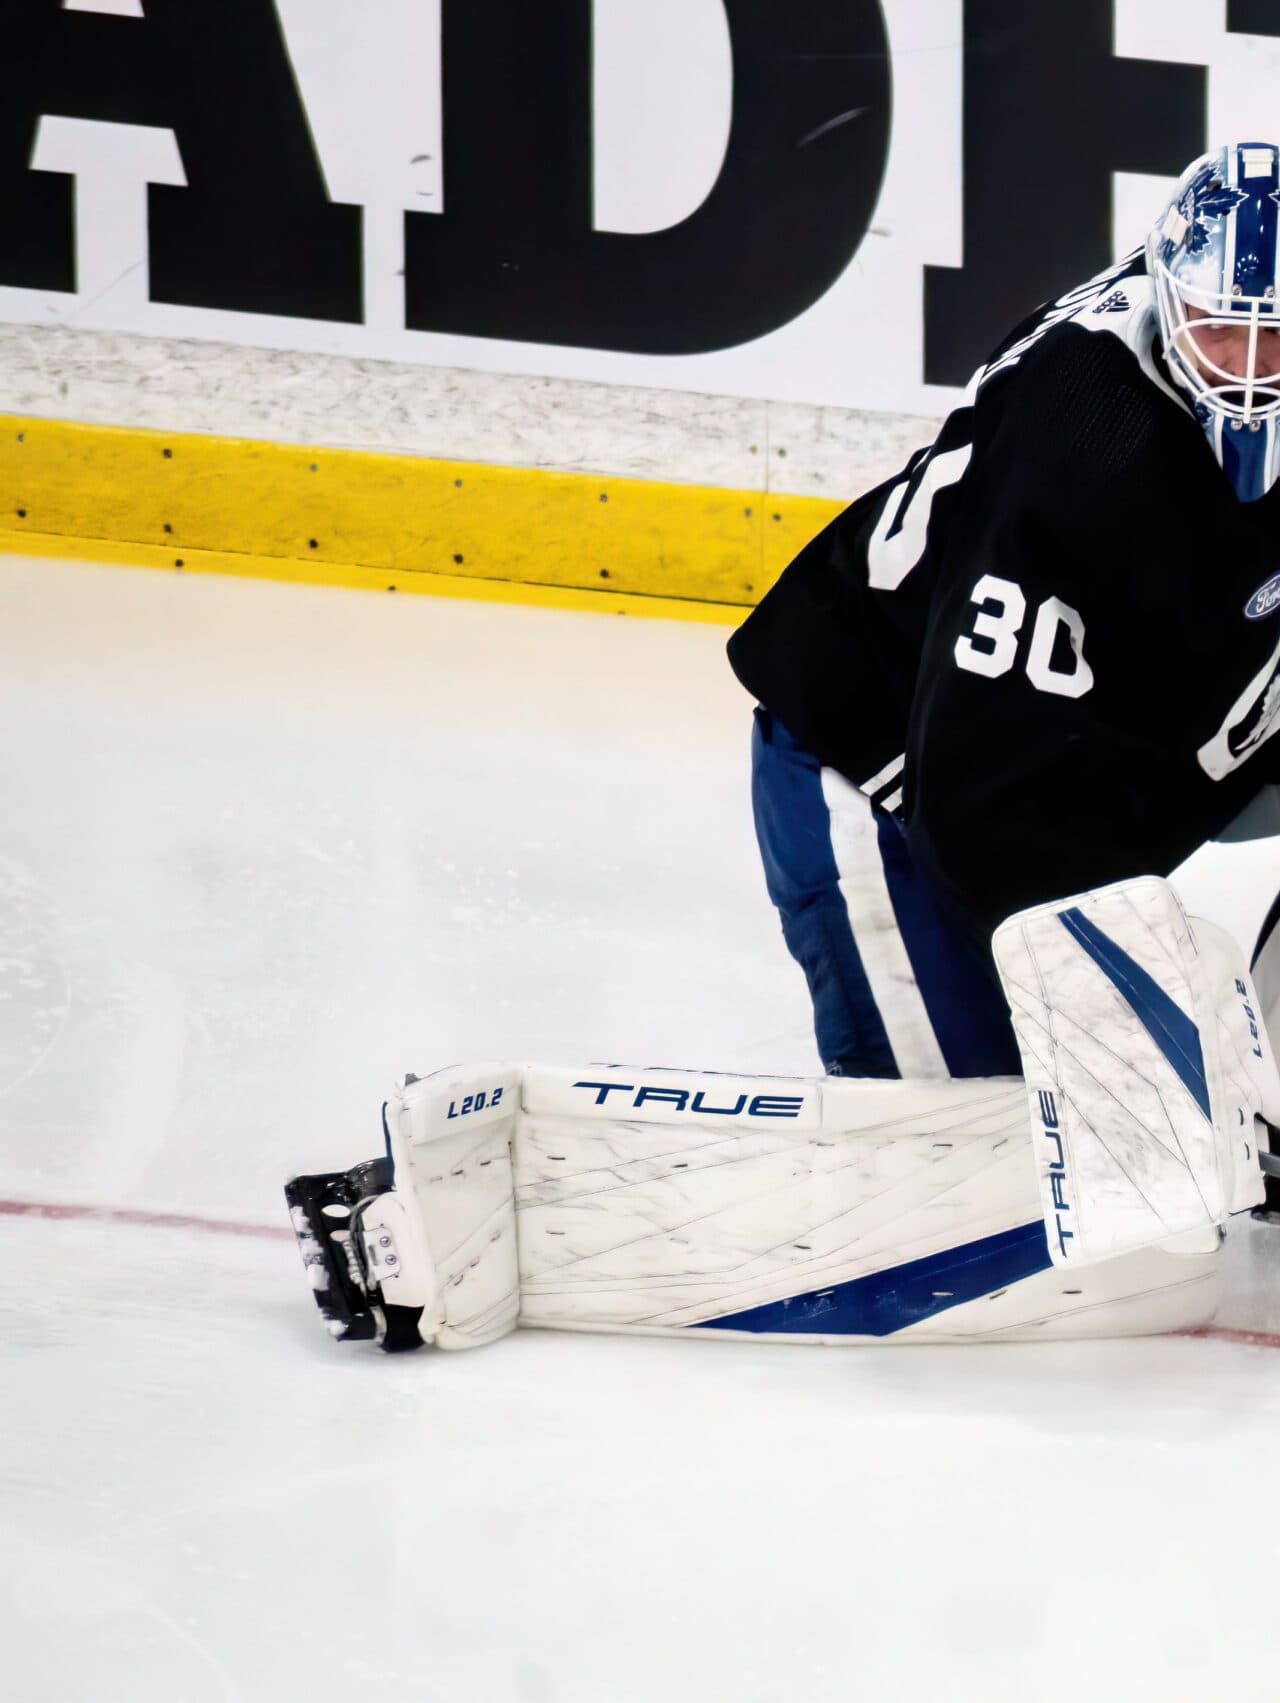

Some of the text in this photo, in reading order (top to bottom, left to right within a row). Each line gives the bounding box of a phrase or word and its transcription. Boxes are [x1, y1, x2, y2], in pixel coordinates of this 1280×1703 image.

[954, 574, 1094, 699] 30
[1234, 978, 1263, 1059] L20.2
[447, 1087, 504, 1120] L20.2
[572, 1081, 804, 1118] TRUE
[1037, 1089, 1074, 1259] TRUE
